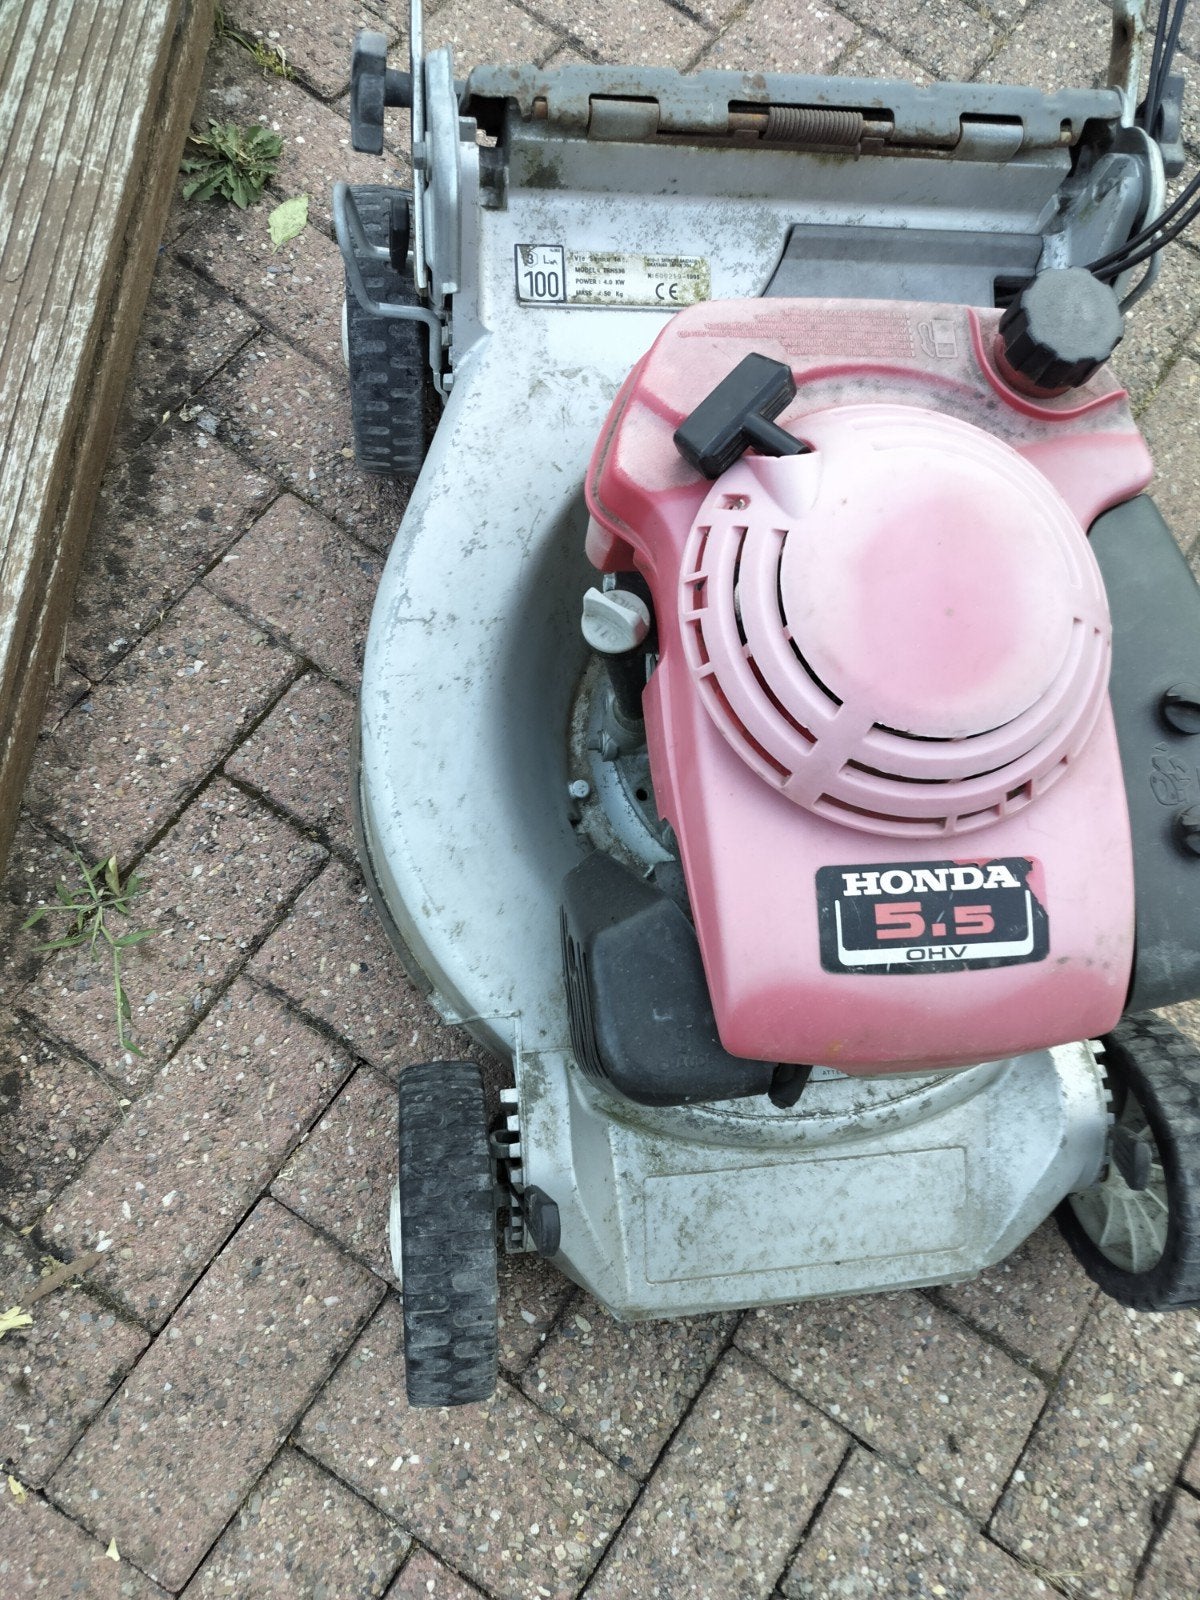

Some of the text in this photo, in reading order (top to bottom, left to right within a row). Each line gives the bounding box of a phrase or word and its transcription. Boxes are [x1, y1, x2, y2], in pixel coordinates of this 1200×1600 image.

[524, 270, 559, 298] 100
[842, 865, 1021, 897] HONDA
[874, 901, 995, 940] 5.5
[906, 945, 968, 961] OHV
